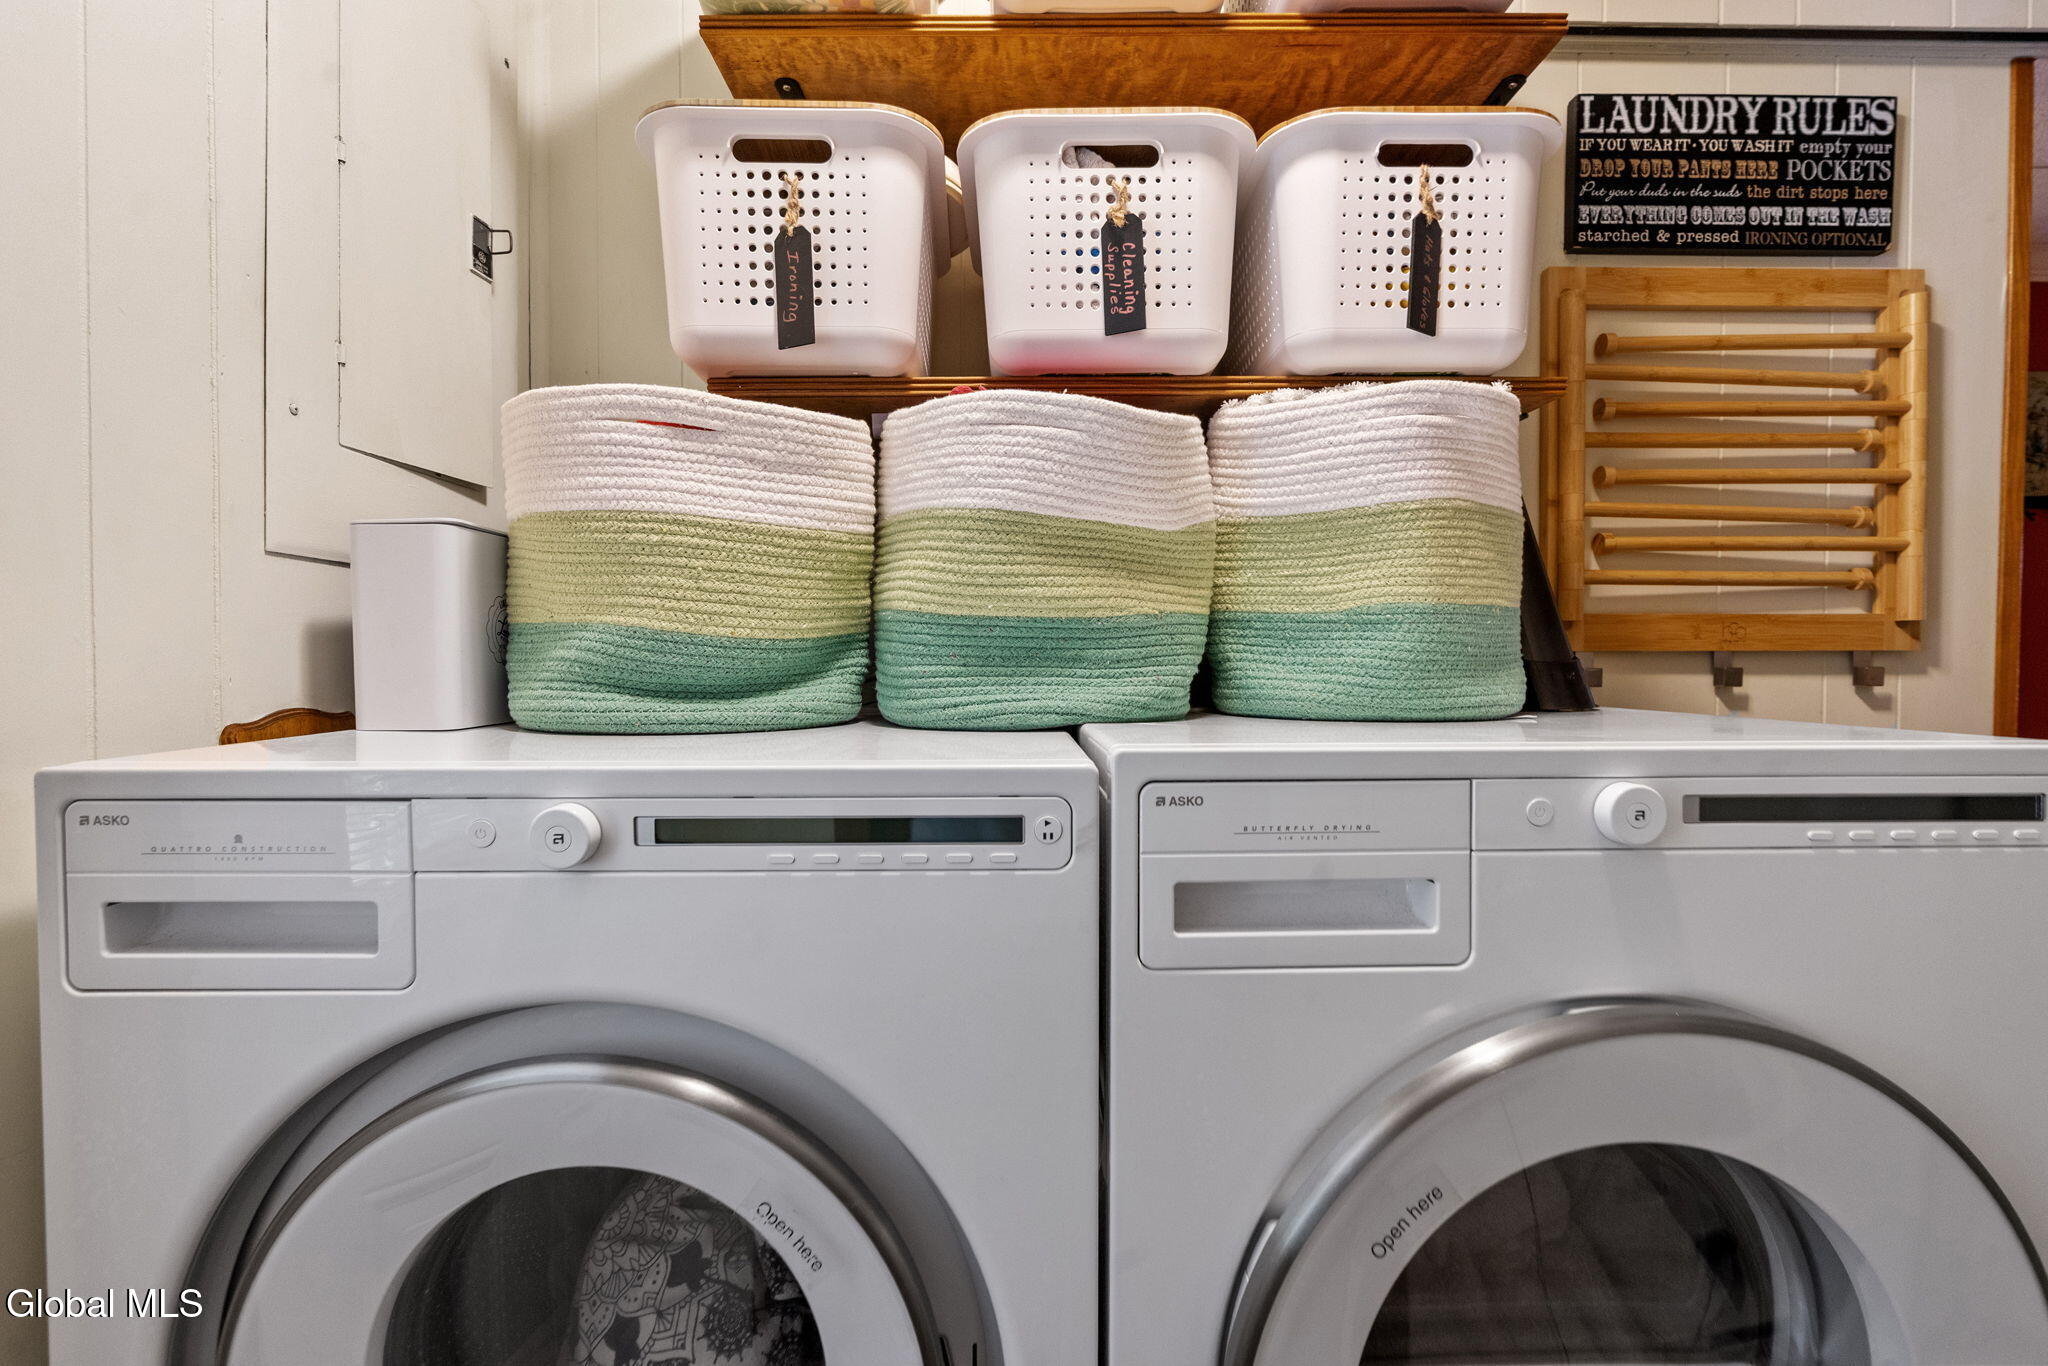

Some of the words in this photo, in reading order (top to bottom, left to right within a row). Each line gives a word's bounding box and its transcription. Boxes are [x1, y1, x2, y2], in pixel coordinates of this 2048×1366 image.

[1579, 95, 1767, 135] LAUNDRY
[1771, 97, 1896, 137] RULES
[1579, 138, 1595, 151] IF
[1596, 138, 1627, 151] YOU
[1629, 138, 1673, 151] WEAR
[1674, 138, 1692, 152] IT
[1699, 138, 1728, 152] YOU
[1731, 139, 1777, 153] WASH
[1777, 139, 1795, 153] IT
[1800, 138, 1852, 158] empty
[1855, 143, 1893, 159] your
[1579, 158, 1626, 178] DROP
[1629, 158, 1674, 178] YOUR
[1678, 158, 1732, 179] PANTS
[1735, 160, 1779, 180] HERE
[1786, 159, 1893, 181] POCKETS
[1579, 180, 1607, 197] Put
[1608, 188, 1637, 202] your
[1638, 182, 1671, 197] duds
[1673, 187, 1689, 197] in
[1690, 183, 1711, 197] the
[1714, 183, 1743, 197] suds
[1746, 185, 1771, 198] the
[1776, 184, 1805, 199] dirt
[1809, 187, 1849, 202] stops
[1854, 186, 1888, 200] here
[1577, 204, 1688, 225] EVERYTHING
[1690, 205, 1746, 225] COMES
[1749, 206, 1783, 226] OUT
[1784, 206, 1804, 226] IN
[1806, 206, 1840, 227] THE
[1842, 207, 1892, 227] WASH
[1577, 229, 1650, 242] starched
[1656, 229, 1670, 243] &
[1676, 231, 1740, 245] pressed
[1745, 231, 1808, 246] IRONING
[1811, 232, 1888, 247] OPTIONAL
[782, 248, 804, 323] Ironing
[1104, 242, 1122, 315] Supplies
[1119, 242, 1140, 315] Cleaning
[1168, 796, 1204, 807] ASKO
[93, 815, 130, 826] ASKO
[1323, 824, 1372, 832] DRYING
[1371, 1218, 1411, 1259] Open
[1406, 1186, 1443, 1221] here
[756, 1201, 794, 1240] Open
[792, 1234, 823, 1272] here
